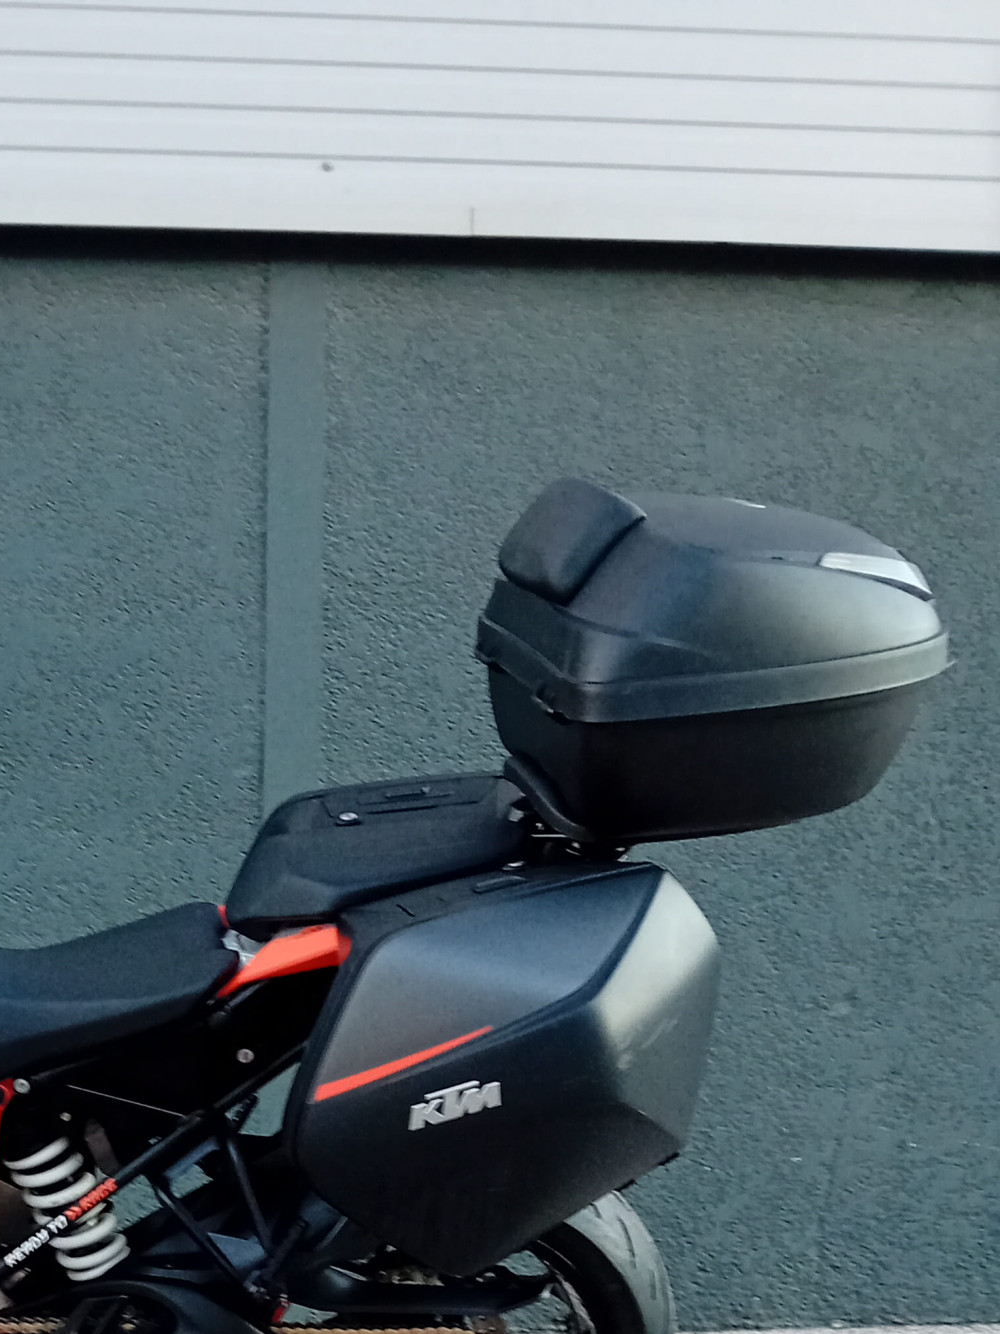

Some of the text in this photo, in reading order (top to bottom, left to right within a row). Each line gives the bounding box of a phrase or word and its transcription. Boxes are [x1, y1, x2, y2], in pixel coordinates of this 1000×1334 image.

[408, 1080, 502, 1131] KTM
[3, 1228, 50, 1268] READY
[46, 1215, 69, 1234] TO
